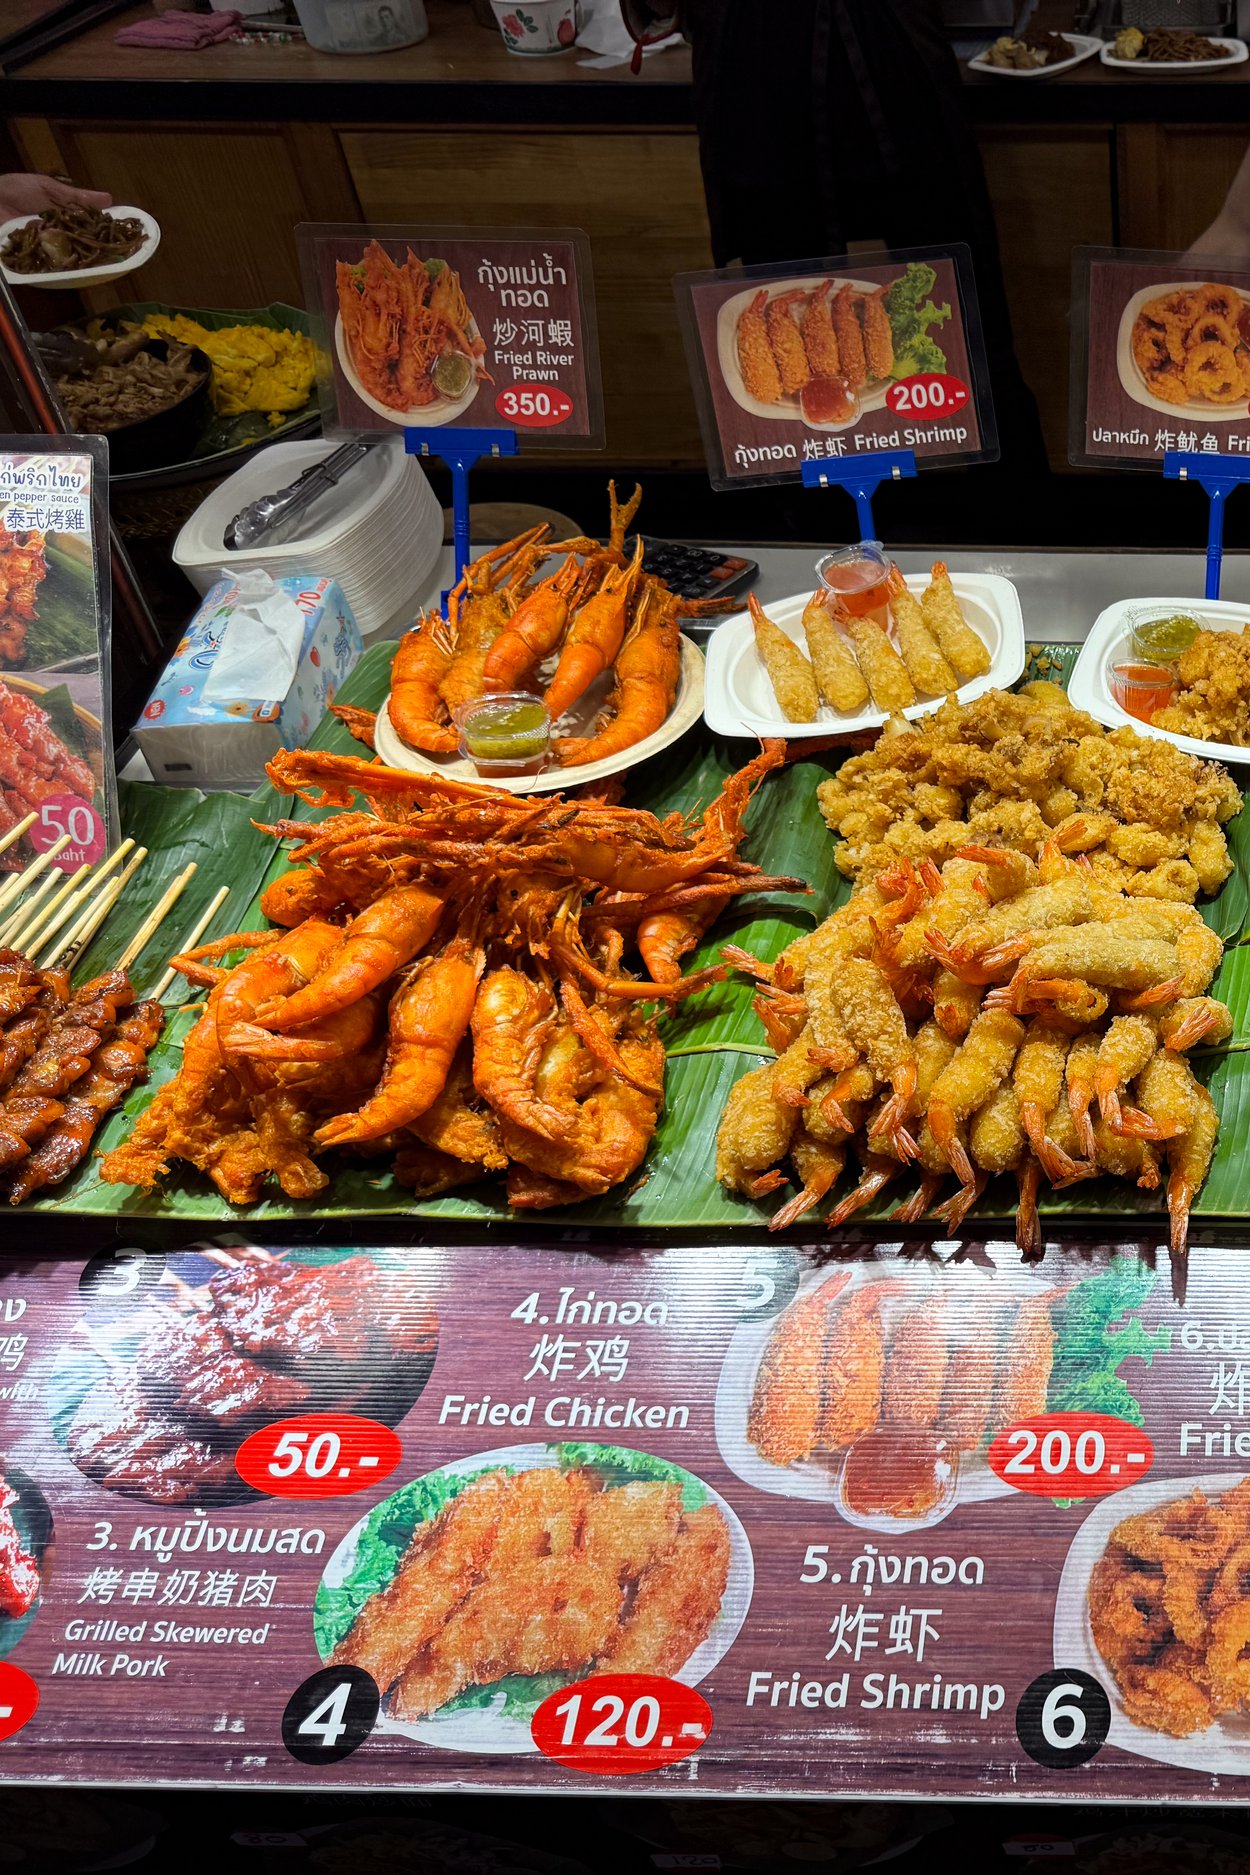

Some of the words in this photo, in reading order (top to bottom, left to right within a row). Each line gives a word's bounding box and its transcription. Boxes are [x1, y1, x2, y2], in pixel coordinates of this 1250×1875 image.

[477, 253, 567, 292] กุ้งแม่น้ำ
[500, 289, 549, 307] ทอด
[492, 317, 574, 347] 炒河蝦
[494, 350, 532, 365] Fried
[536, 351, 574, 366] River
[512, 366, 559, 380] Prawn
[503, 392, 570, 416] 350.-
[893, 382, 966, 411] 200.-
[734, 443, 797, 469] กุ้งทอด
[802, 437, 848, 461] 炸虾
[854, 431, 900, 451] Fried
[904, 426, 968, 446] Shrimp
[1092, 427, 1149, 445] ปลาหมึก
[1154, 429, 1220, 454] 炸鱿鱼
[13, 492, 47, 503] pepper
[51, 494, 79, 504] sauce
[7, 508, 85, 530] 泰式烤雞
[41, 805, 94, 845] 50
[98, 1248, 147, 1296] 3
[736, 1259, 778, 1308] 5
[523, 1333, 631, 1382] 炸鸡
[438, 1395, 537, 1427] Fried
[543, 1396, 691, 1429] Chicken
[268, 1432, 379, 1479] 50.-
[1004, 1429, 1146, 1475] 200.-
[86, 1522, 118, 1551] 3.
[130, 1508, 326, 1563] หมูปิ้งนมสด
[77, 1566, 278, 1608] 烤串奶猪肉
[64, 1620, 145, 1643] Grilled
[149, 1620, 270, 1645] Skewered
[825, 1605, 944, 1663] 炸虾
[51, 1653, 105, 1676] Milk
[110, 1653, 171, 1678] Pork
[298, 1683, 352, 1747] 4
[746, 1671, 857, 1709] Fried
[861, 1673, 1006, 1719] Shrimp
[554, 1695, 706, 1748] 120.-
[1041, 1683, 1086, 1750] 6
